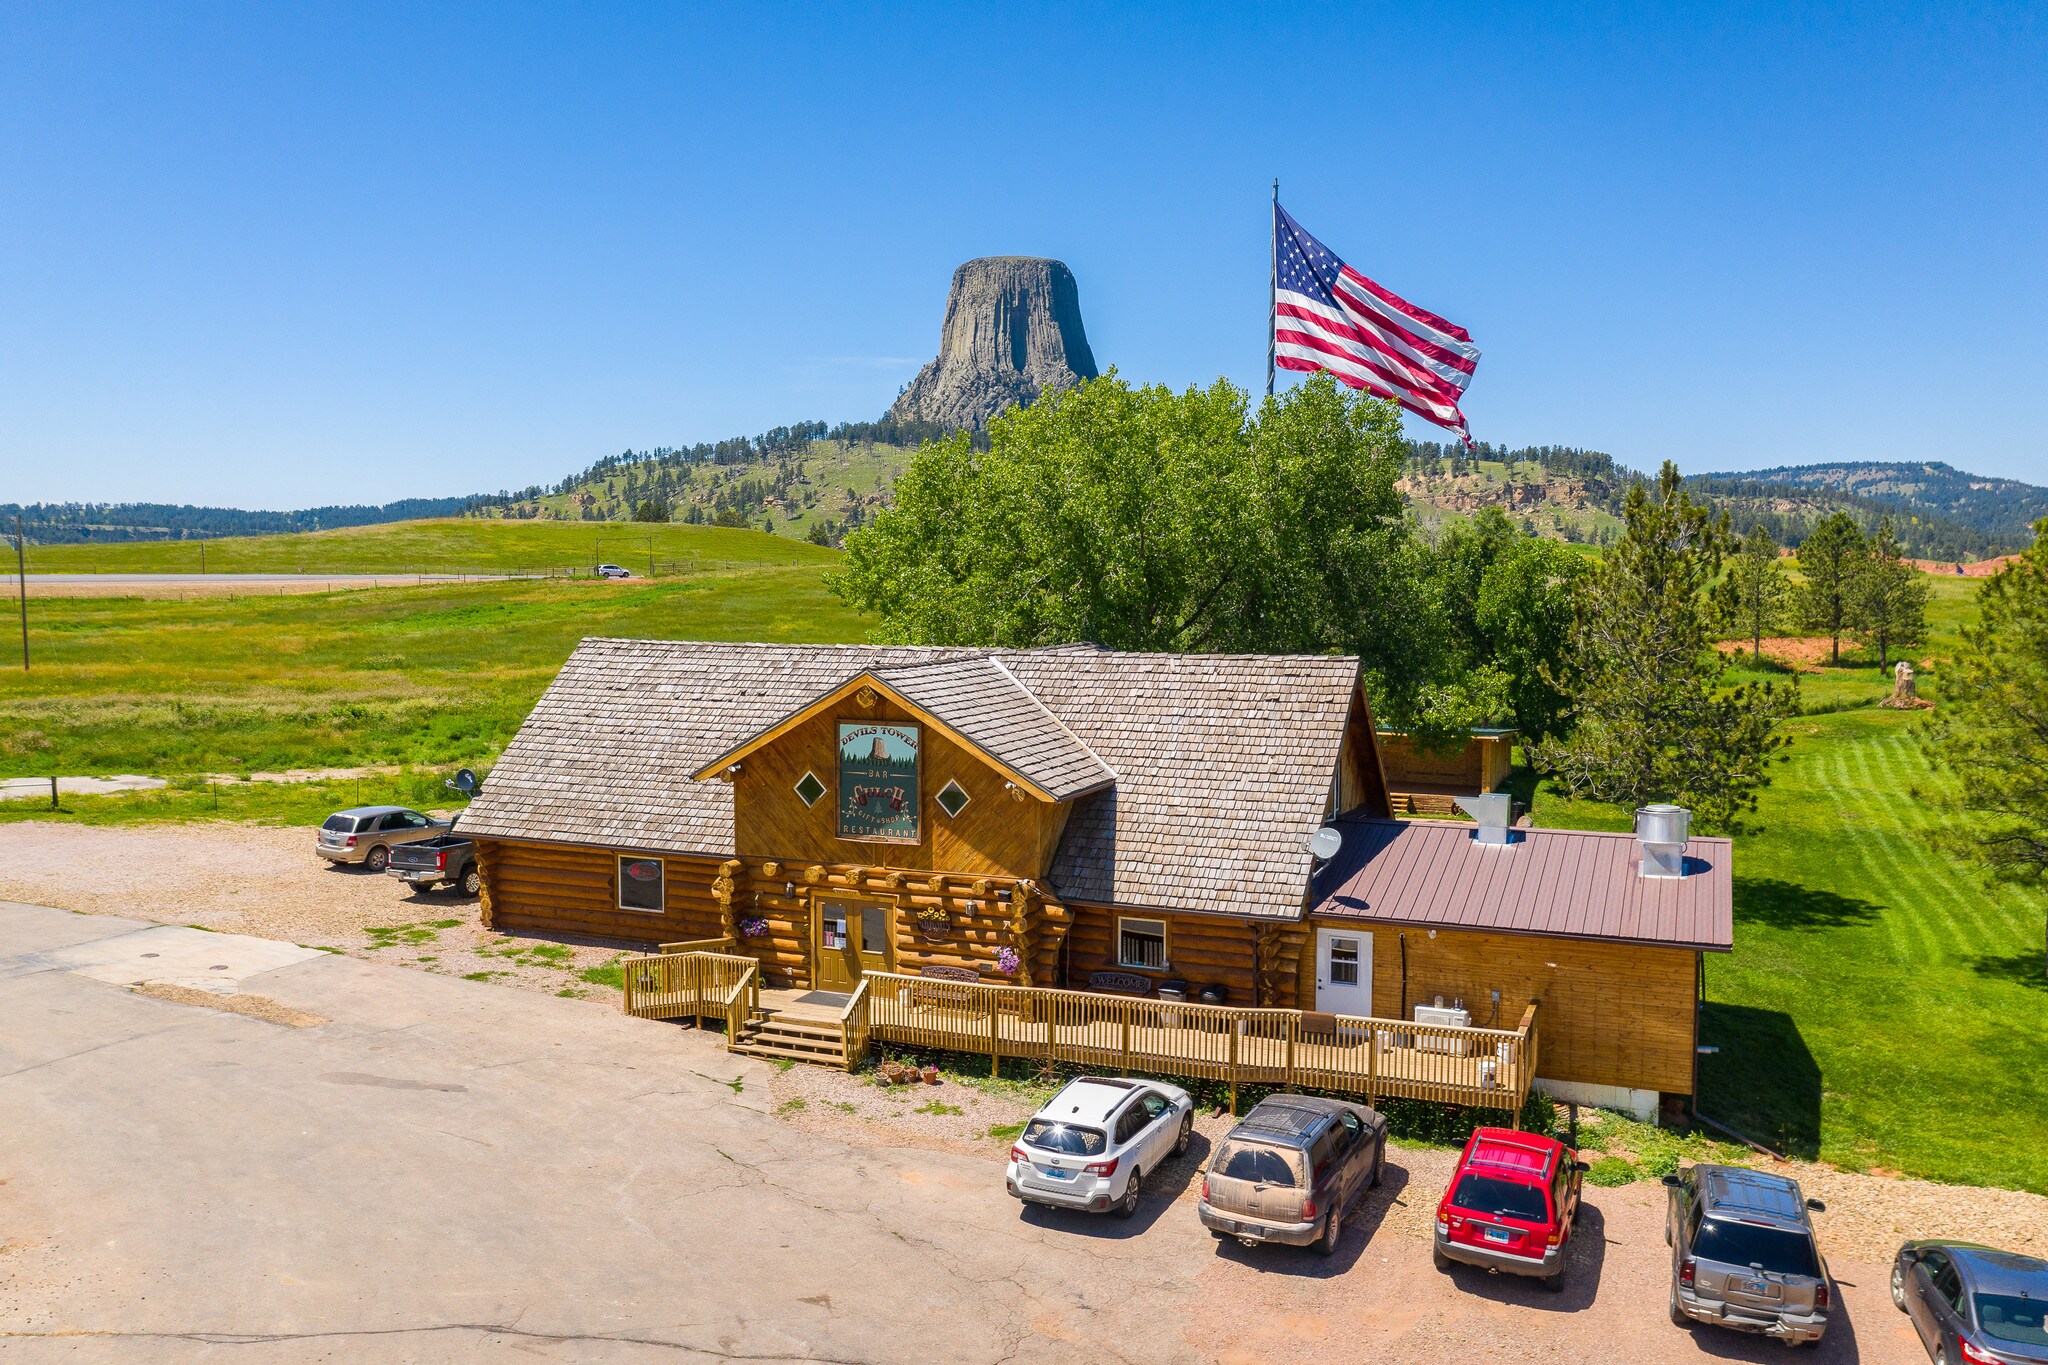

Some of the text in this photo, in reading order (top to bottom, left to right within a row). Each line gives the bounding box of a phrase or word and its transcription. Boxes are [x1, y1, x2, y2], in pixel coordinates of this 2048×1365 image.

[841, 726, 919, 750] DEVILS TOWER
[868, 769, 888, 779] BAR
[854, 784, 905, 811] GULCH
[858, 810, 900, 824] GIFT SHOP
[843, 824, 916, 838] RESTAURANT
